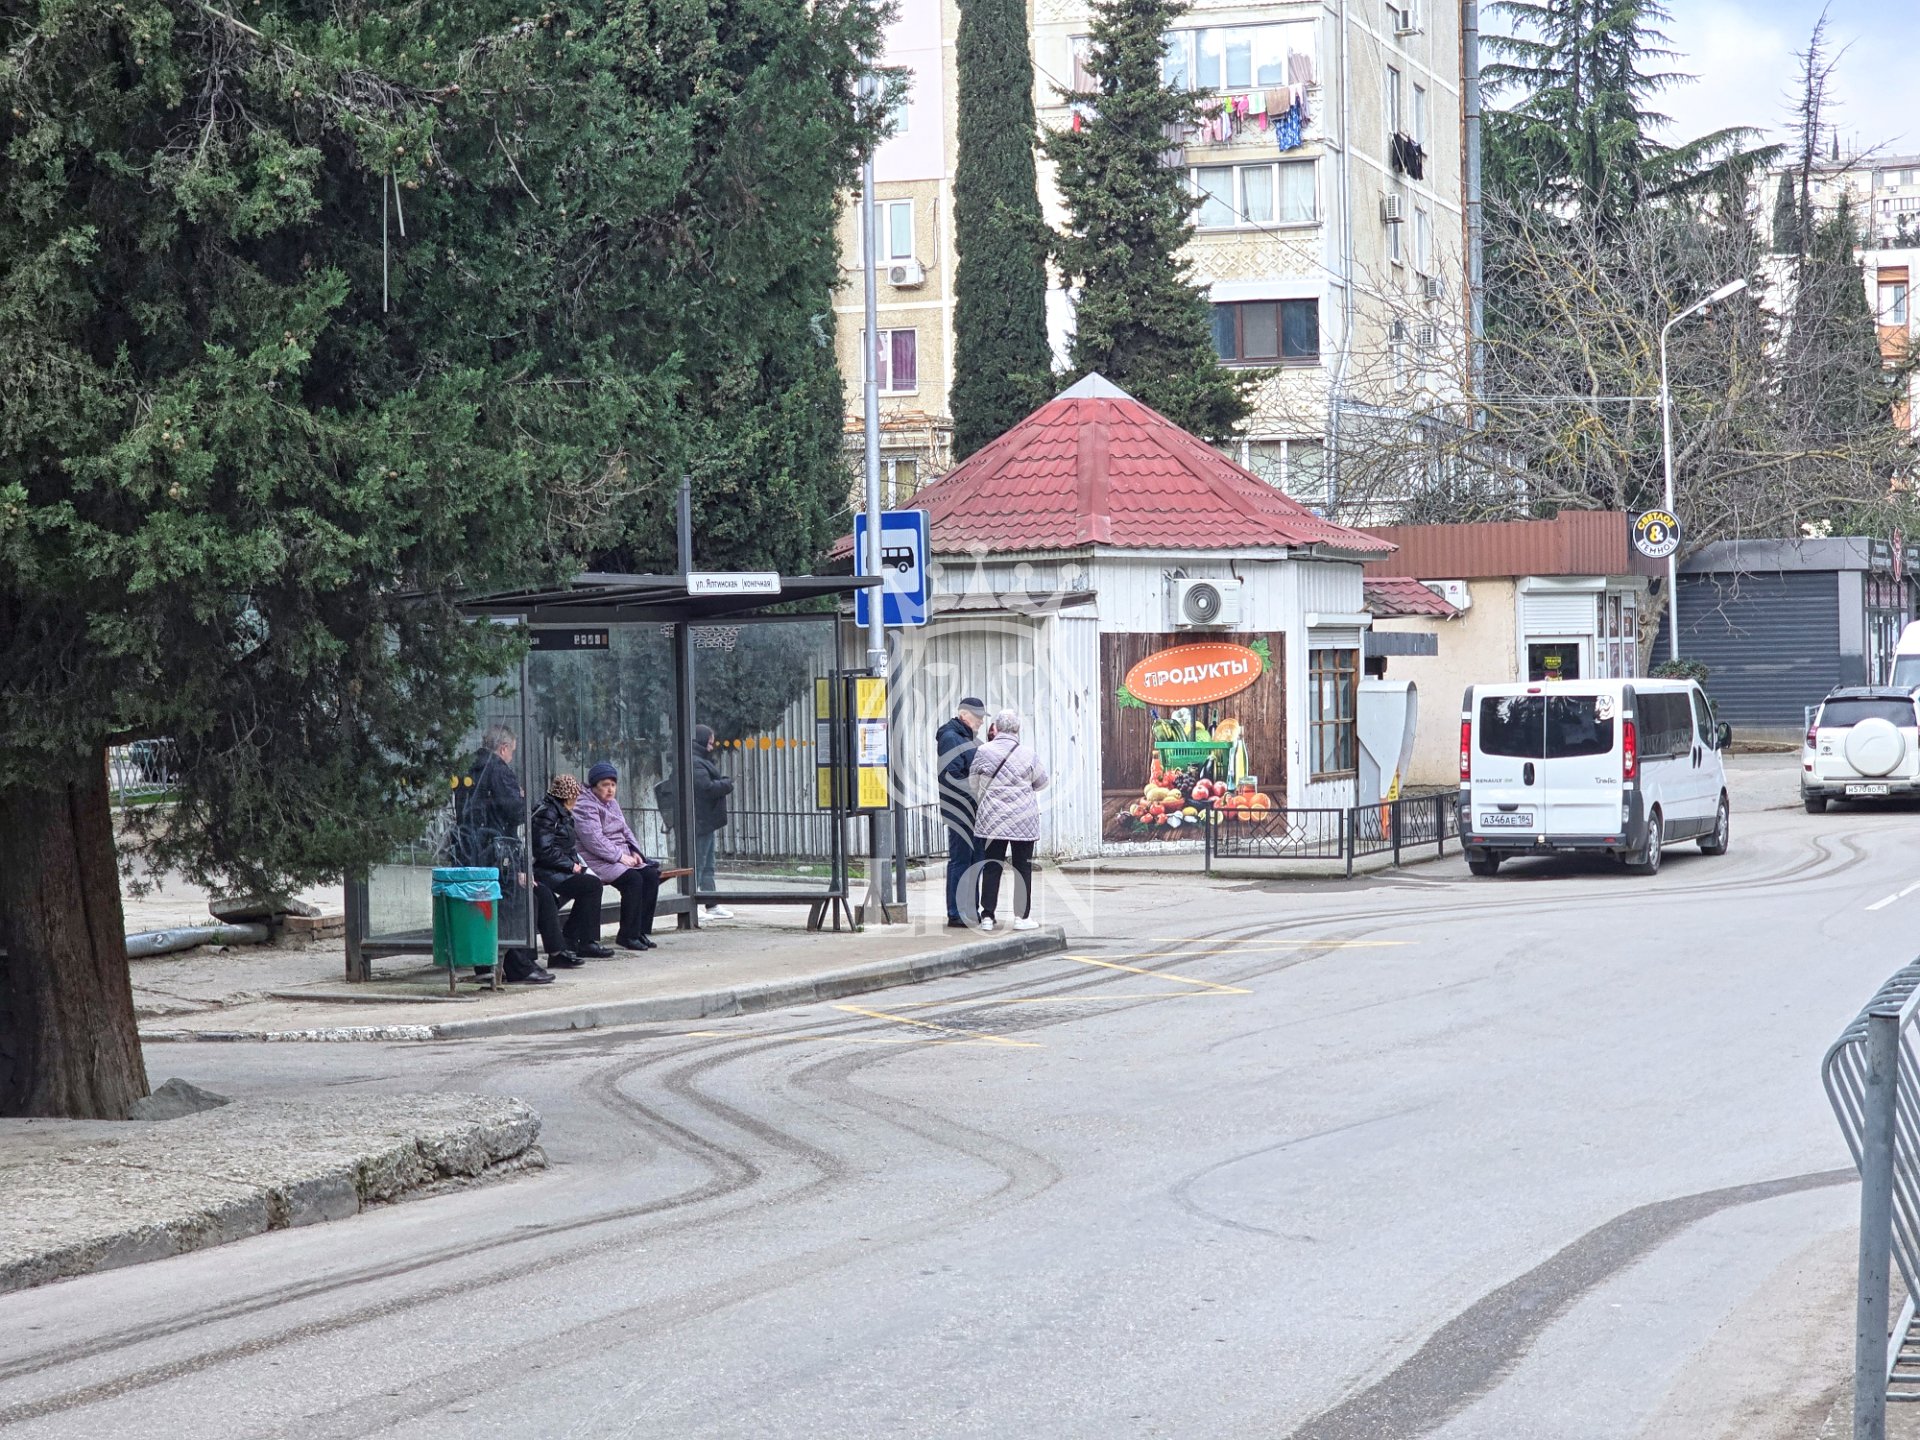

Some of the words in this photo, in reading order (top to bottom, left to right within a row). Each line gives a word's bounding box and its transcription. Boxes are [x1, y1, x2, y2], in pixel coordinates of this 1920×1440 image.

[1637, 512, 1675, 530] СВЕТЛОЕ
[1650, 524, 1664, 542] &
[1640, 540, 1675, 554] ТЕМНОЕ
[1143, 658, 1249, 688] ПРОДУКТЫ
